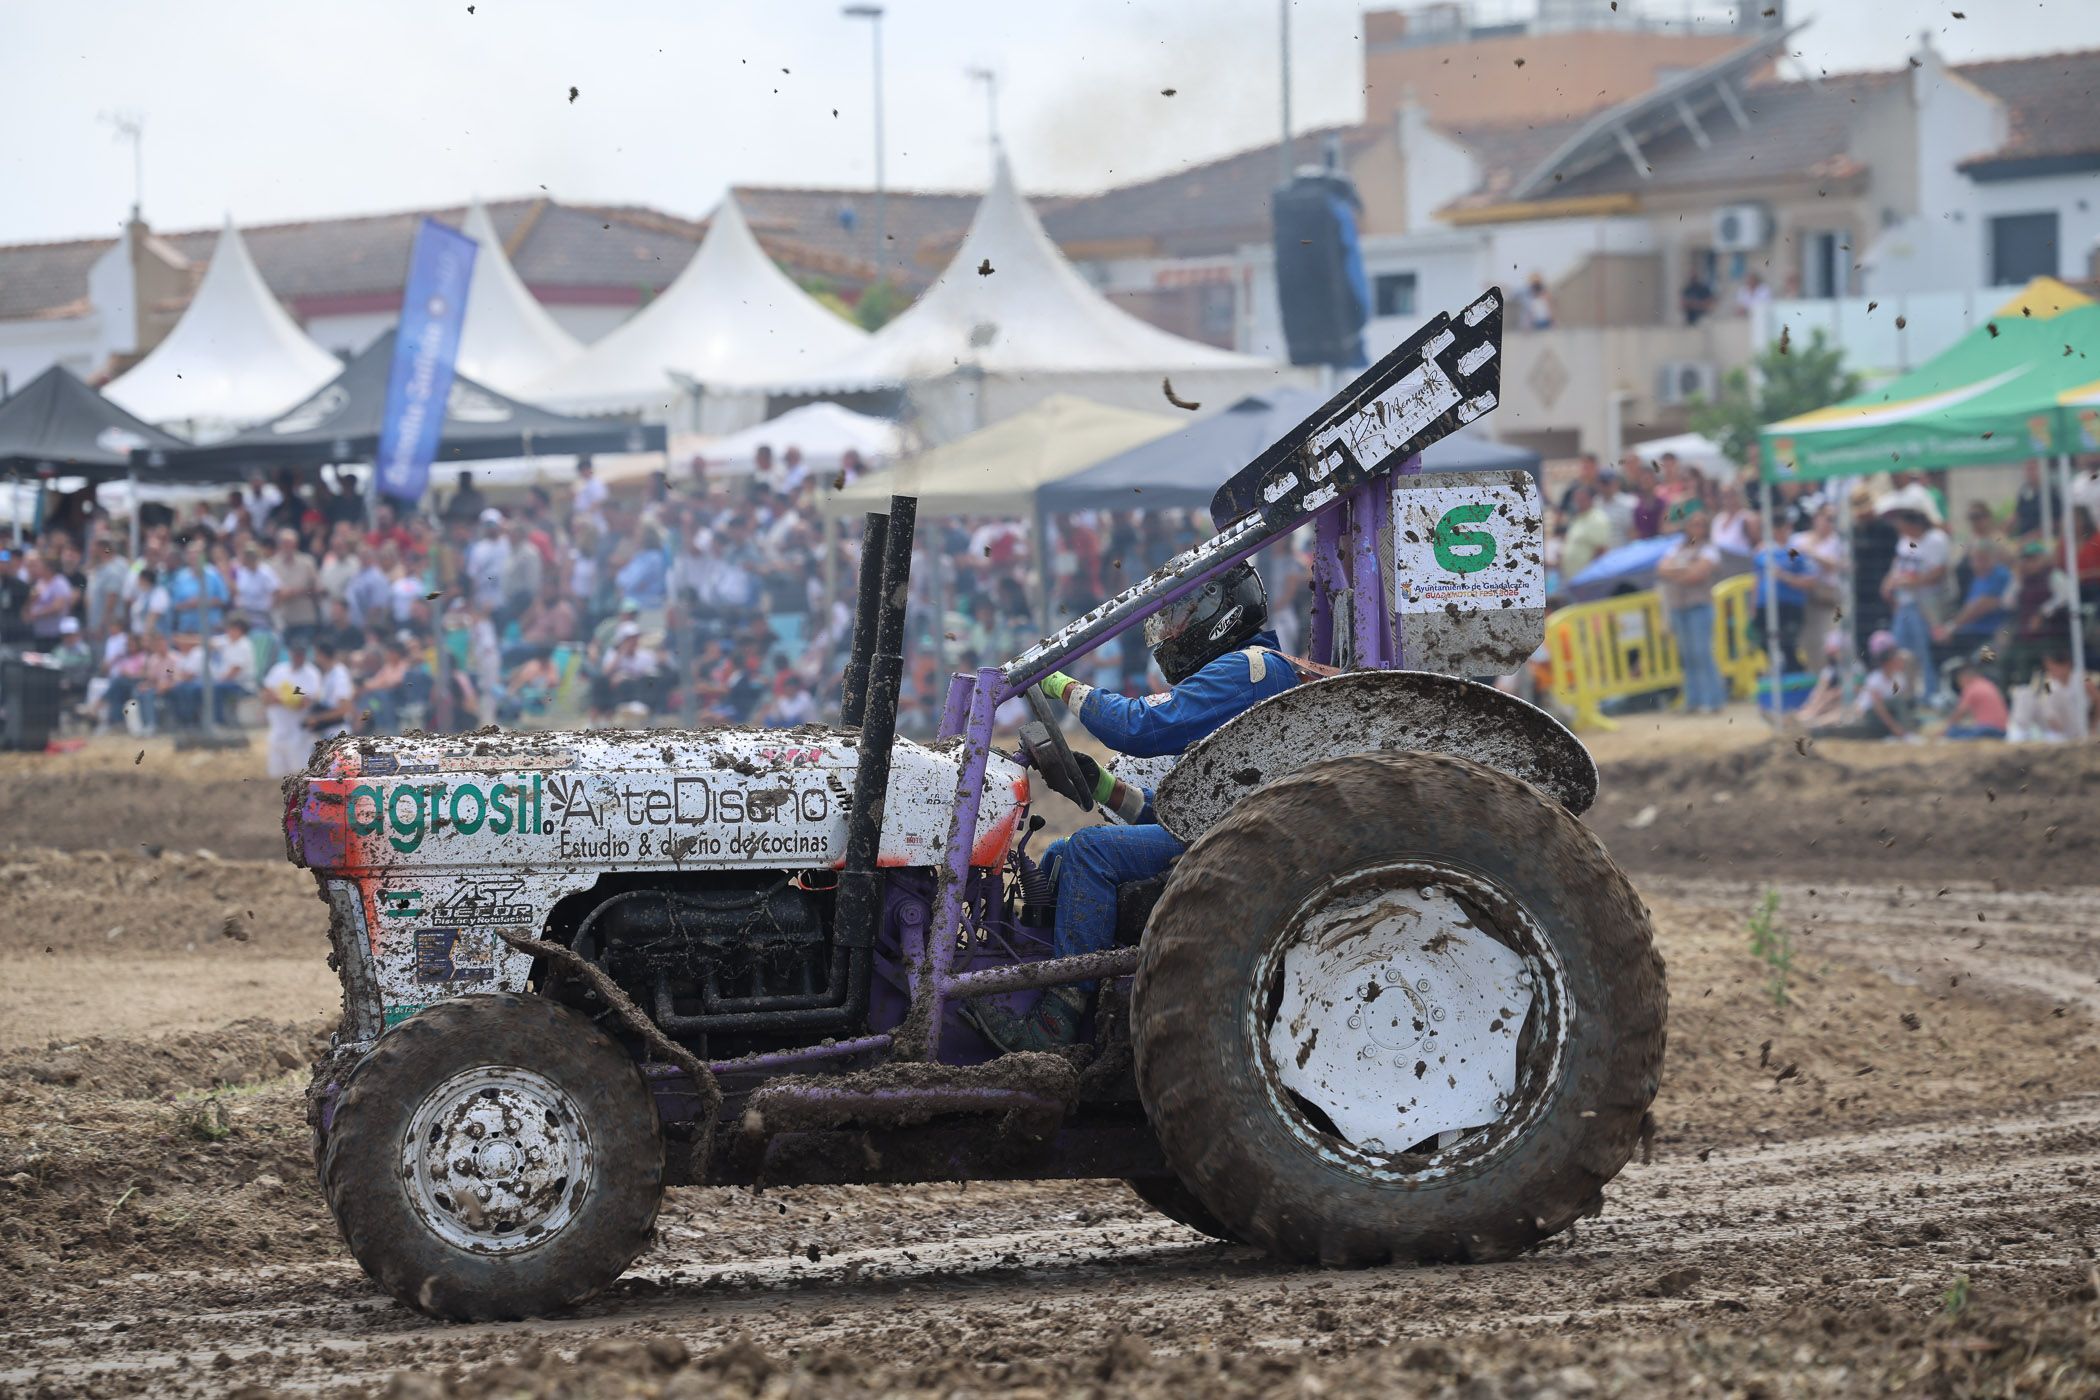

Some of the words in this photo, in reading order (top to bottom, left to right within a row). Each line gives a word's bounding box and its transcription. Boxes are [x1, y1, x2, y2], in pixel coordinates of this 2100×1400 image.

[1433, 504, 1497, 574] 6
[1415, 583, 1469, 593] Ayuntamiento
[1471, 583, 1482, 591] de
[349, 775, 542, 854] agrosil
[560, 829, 630, 859] Estudio
[639, 832, 653, 857] &
[730, 826, 752, 854] de
[761, 830, 828, 854] cocinas
